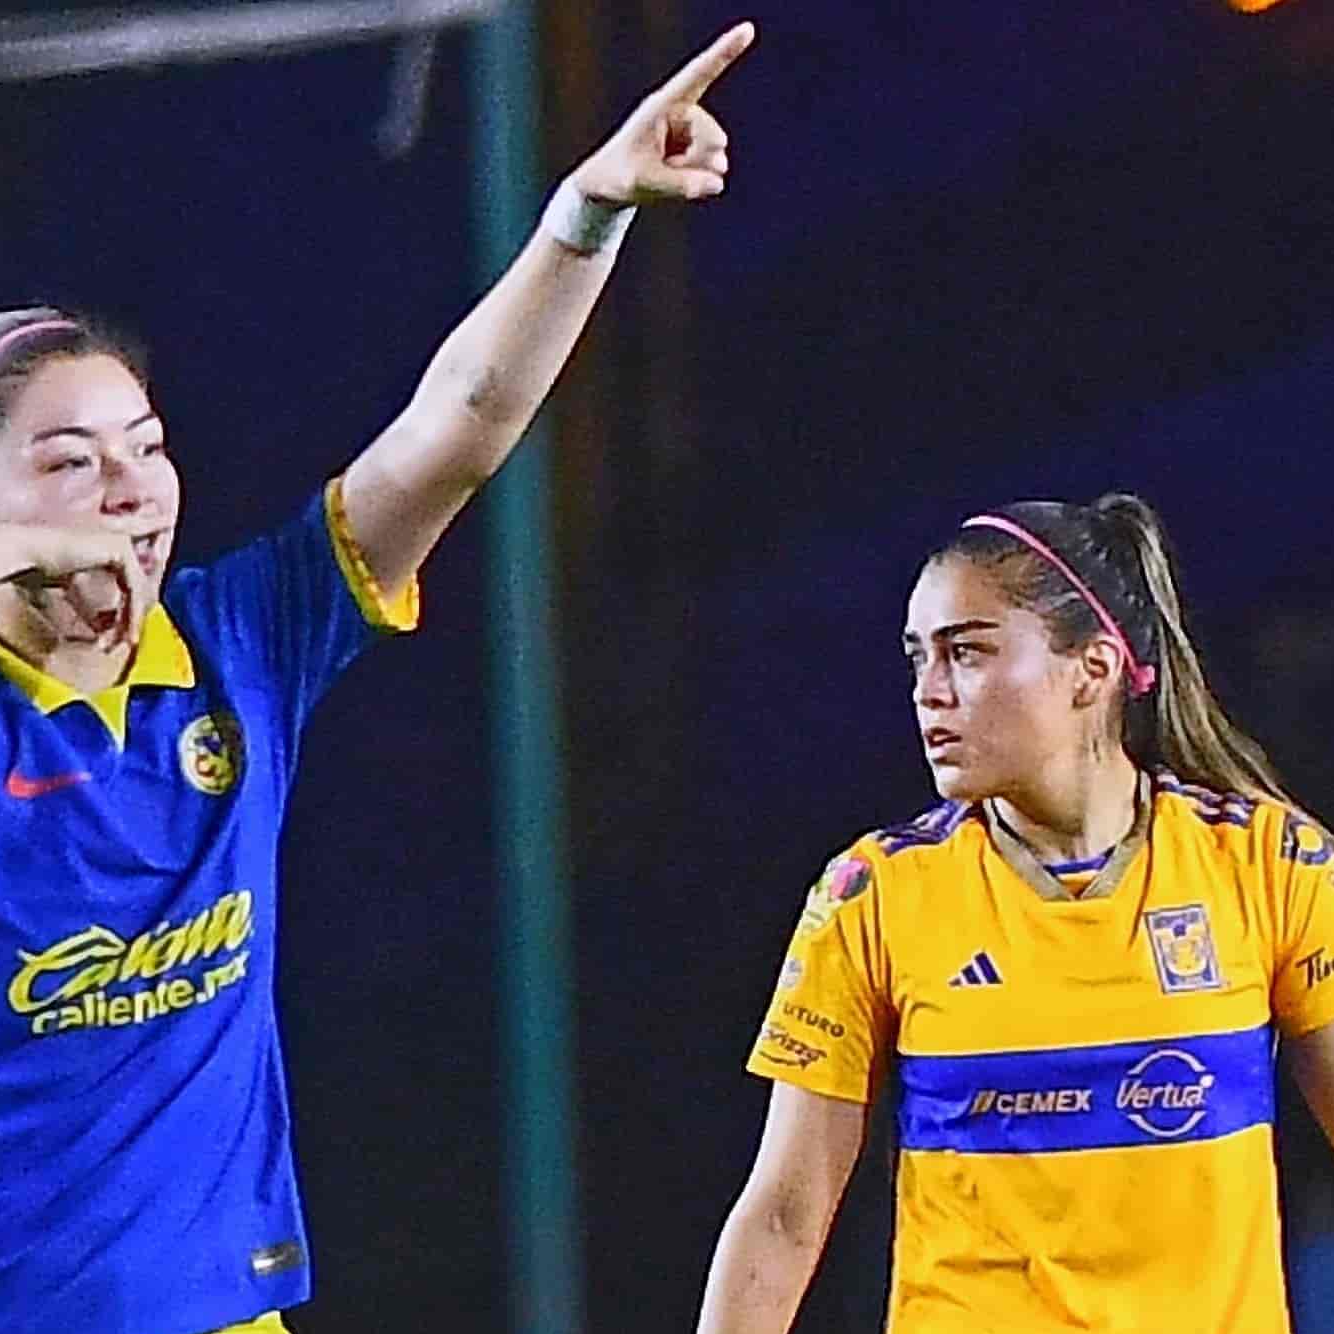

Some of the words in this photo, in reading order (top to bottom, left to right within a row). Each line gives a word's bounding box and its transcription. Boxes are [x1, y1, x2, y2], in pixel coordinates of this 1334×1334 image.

[782, 1003, 846, 1039] UTURO
[995, 1088, 1093, 1115] CEMEX
[1115, 1077, 1208, 1110] Vertua
